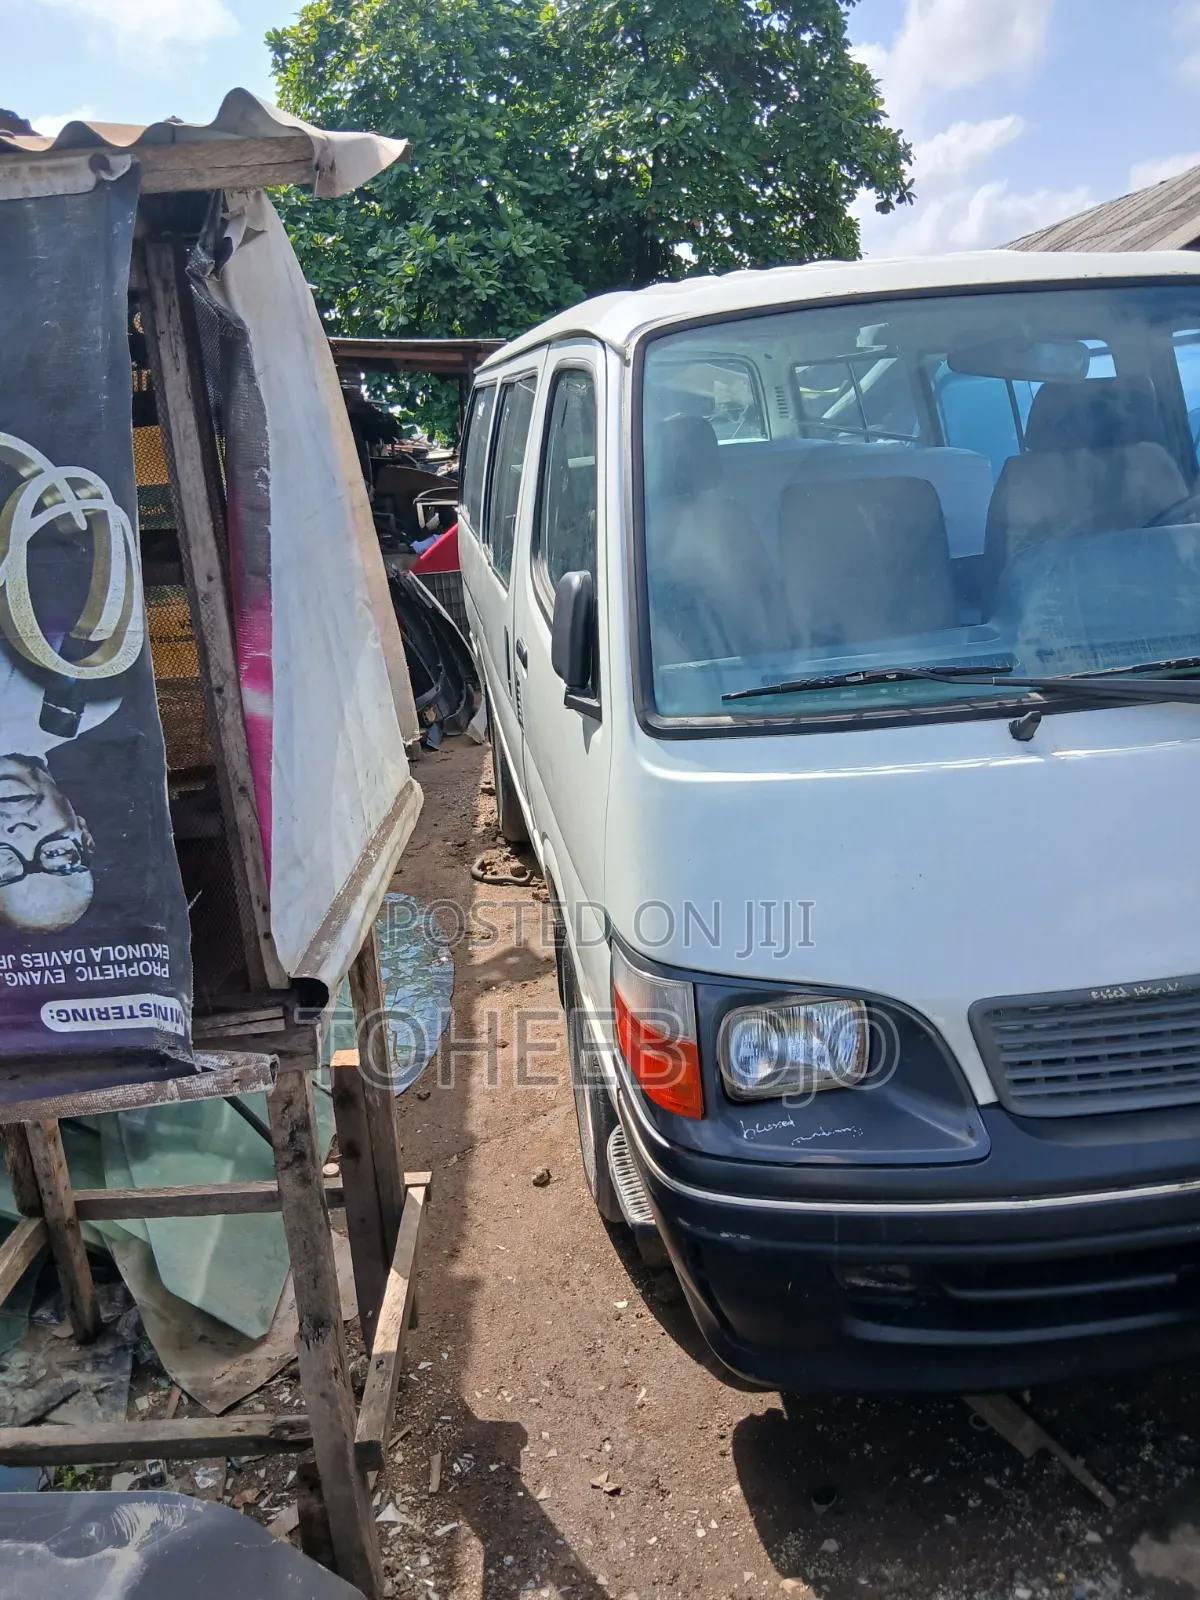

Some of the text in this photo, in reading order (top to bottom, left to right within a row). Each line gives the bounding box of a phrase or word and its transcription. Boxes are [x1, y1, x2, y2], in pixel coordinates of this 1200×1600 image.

[22, 949, 86, 968] DAVIES
[90, 943, 170, 962] EKUNOLA
[0, 960, 170, 986] PROPHETIC EVANG.
[48, 1003, 185, 1027] MINISTERING:
